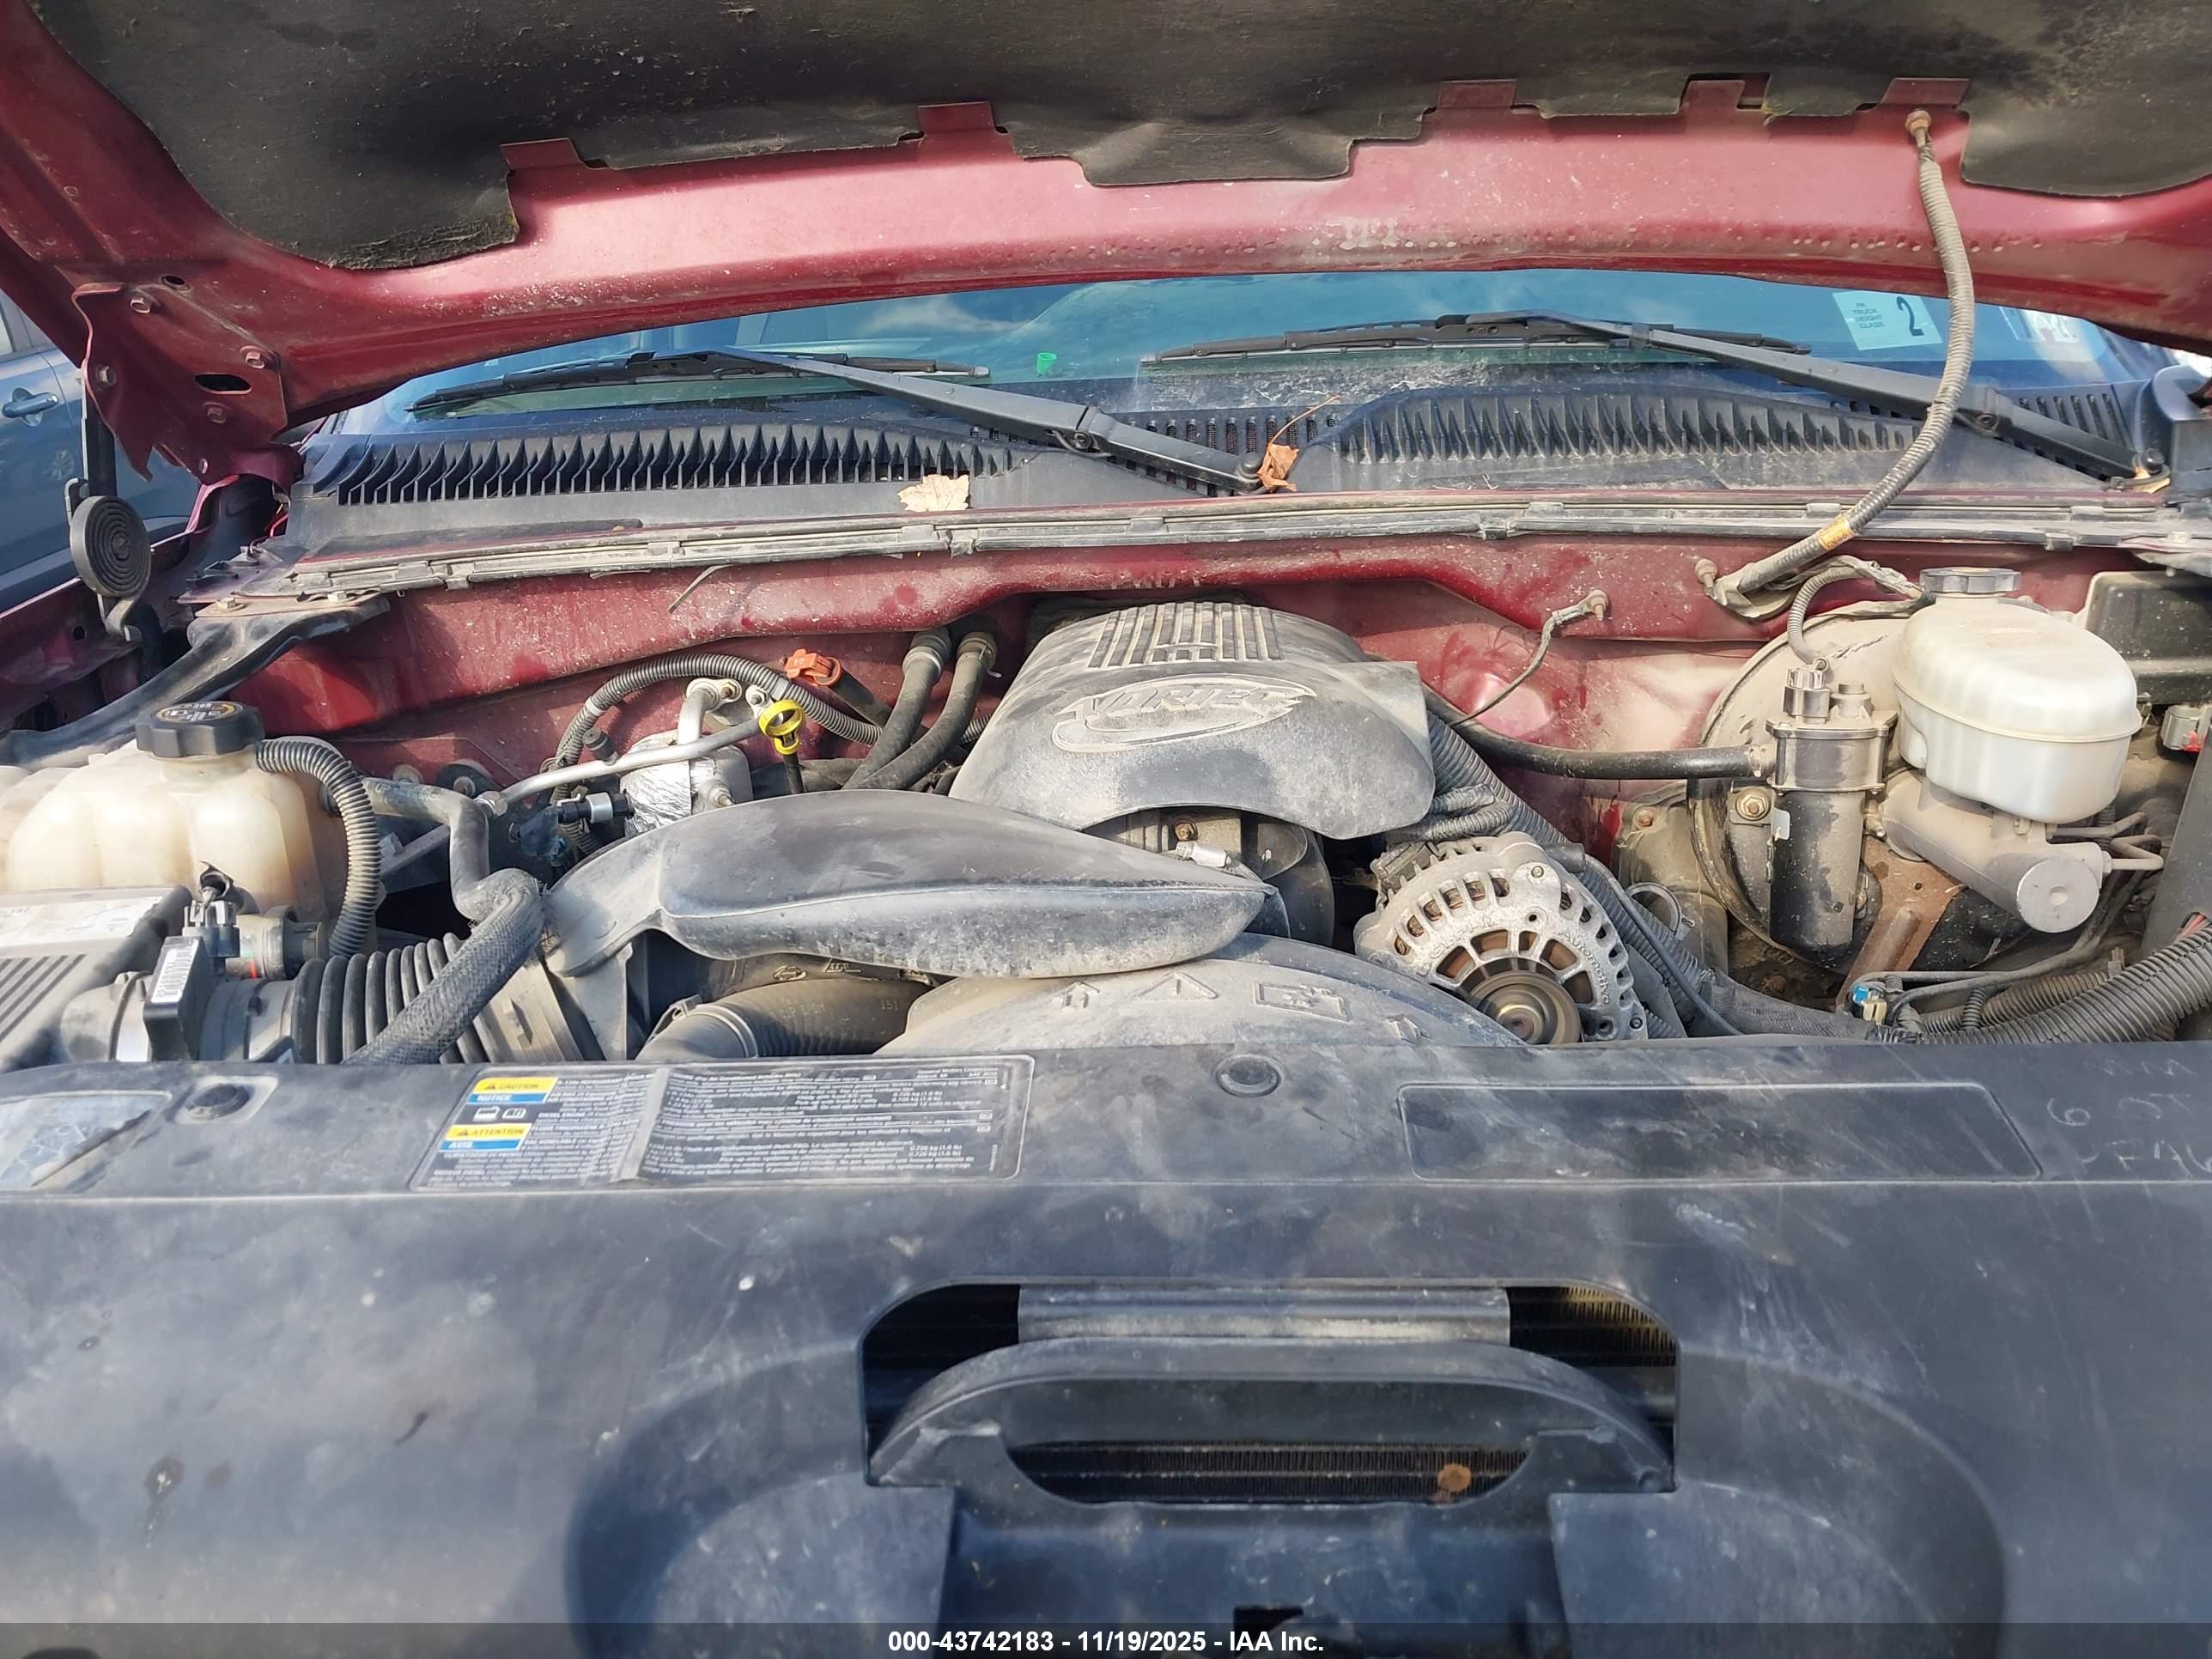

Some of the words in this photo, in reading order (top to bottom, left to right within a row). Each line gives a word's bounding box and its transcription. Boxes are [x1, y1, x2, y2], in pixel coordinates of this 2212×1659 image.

[1896, 296, 1924, 336] 2
[477, 1093, 513, 1102] NOTICE
[447, 1140, 473, 1149] AVIS
